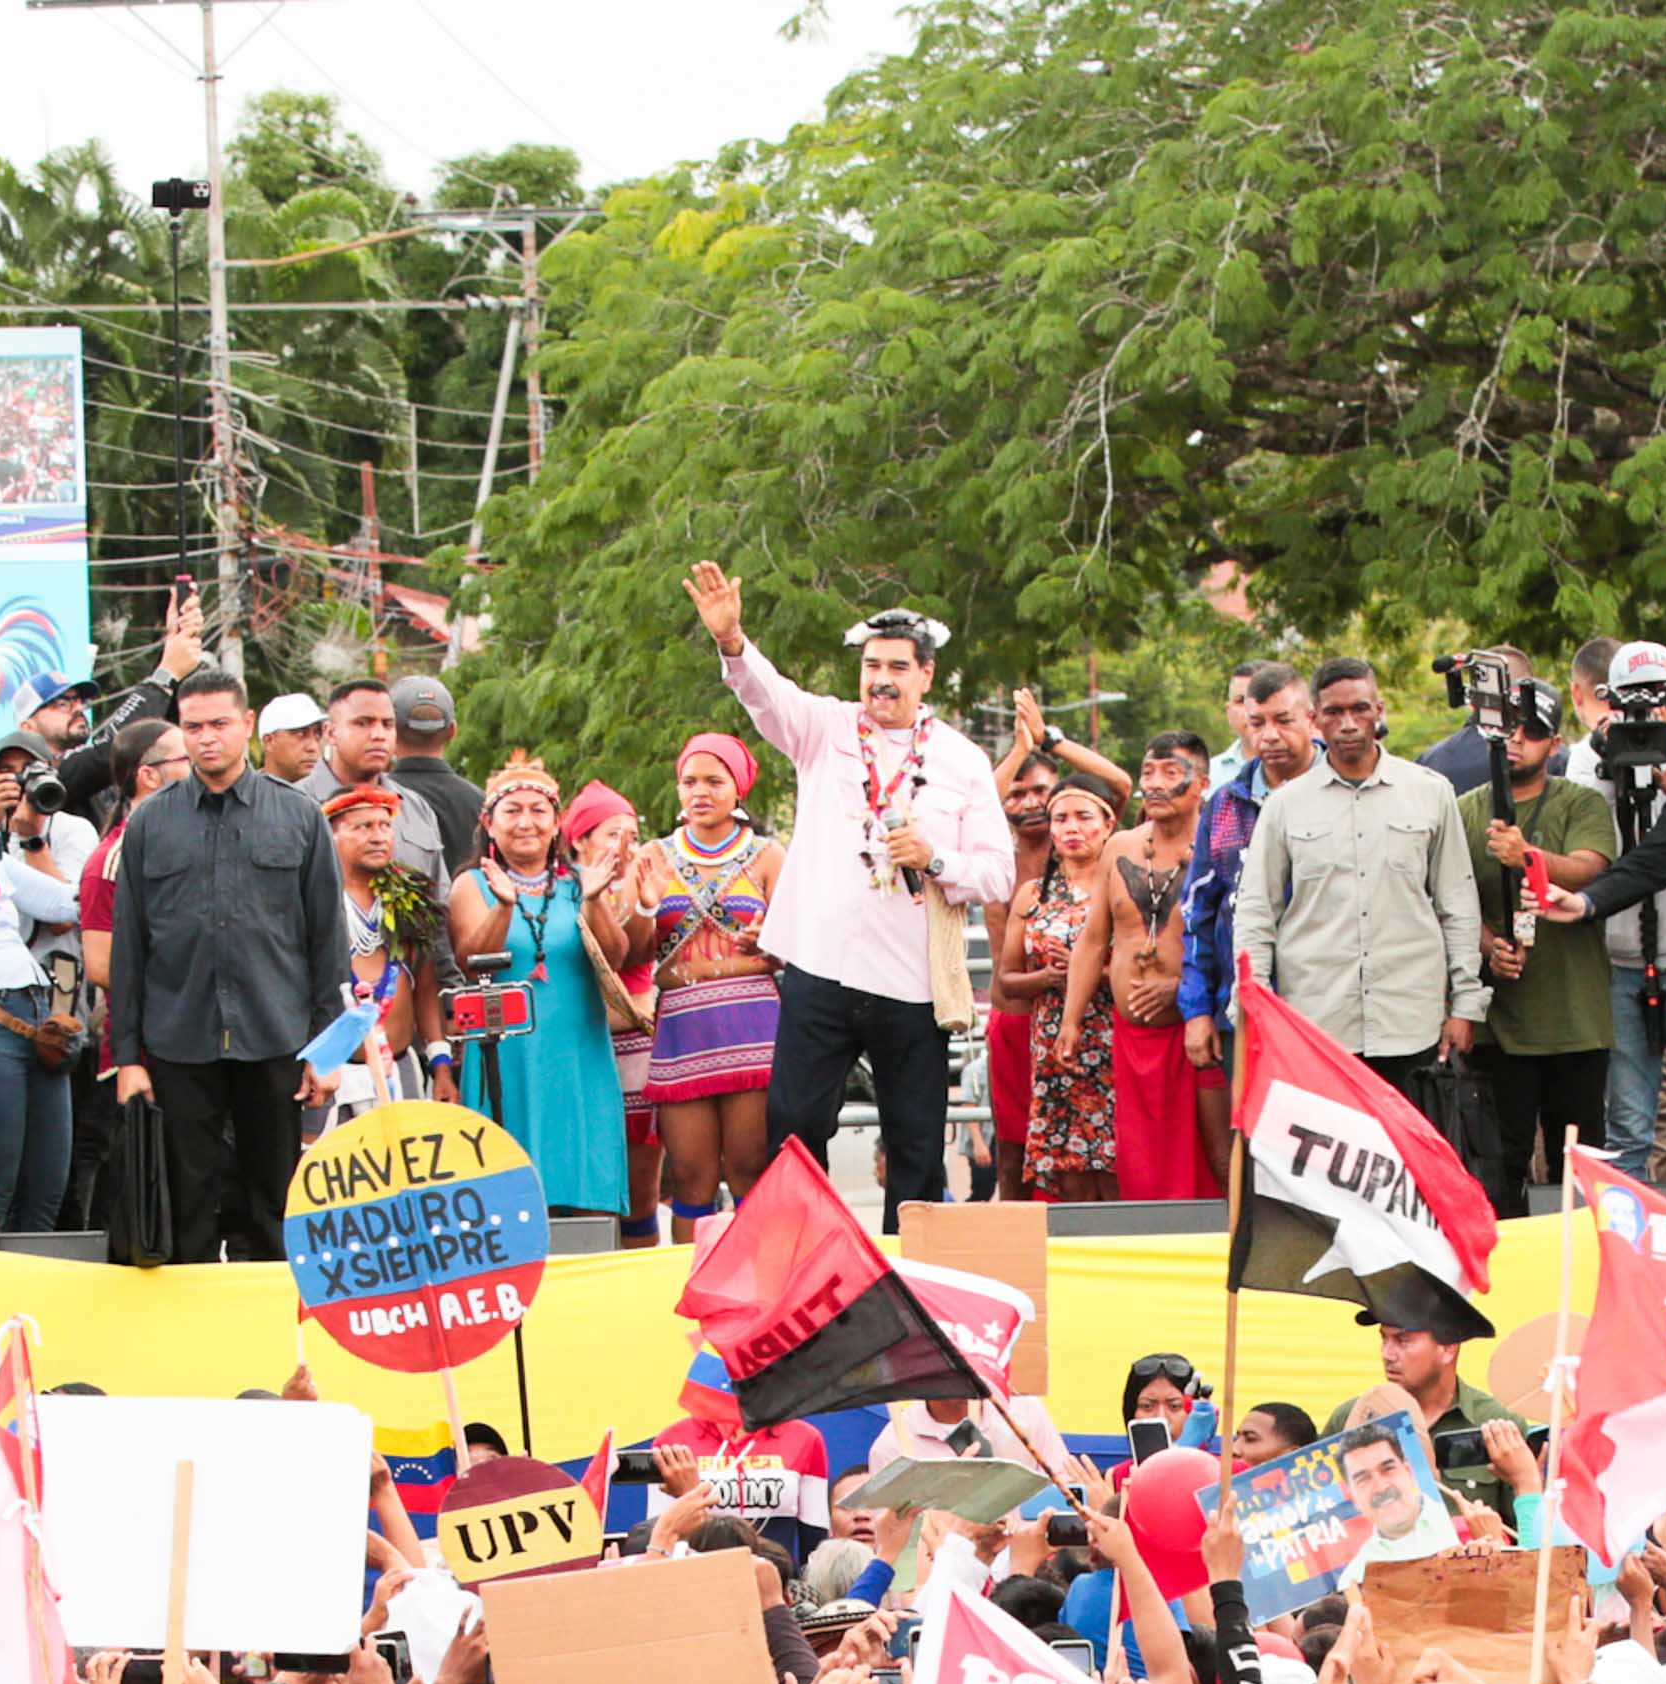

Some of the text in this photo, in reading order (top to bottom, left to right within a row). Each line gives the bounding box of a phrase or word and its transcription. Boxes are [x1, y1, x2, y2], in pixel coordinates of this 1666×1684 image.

[303, 1126, 487, 1206] CHÁVEZ Y
[305, 1187, 487, 1254] MADURO
[348, 1301, 429, 1337] UBCH
[700, 1477, 785, 1509] OMMY
[454, 1500, 576, 1564] UPV
[1260, 1514, 1348, 1571] PATRIA
